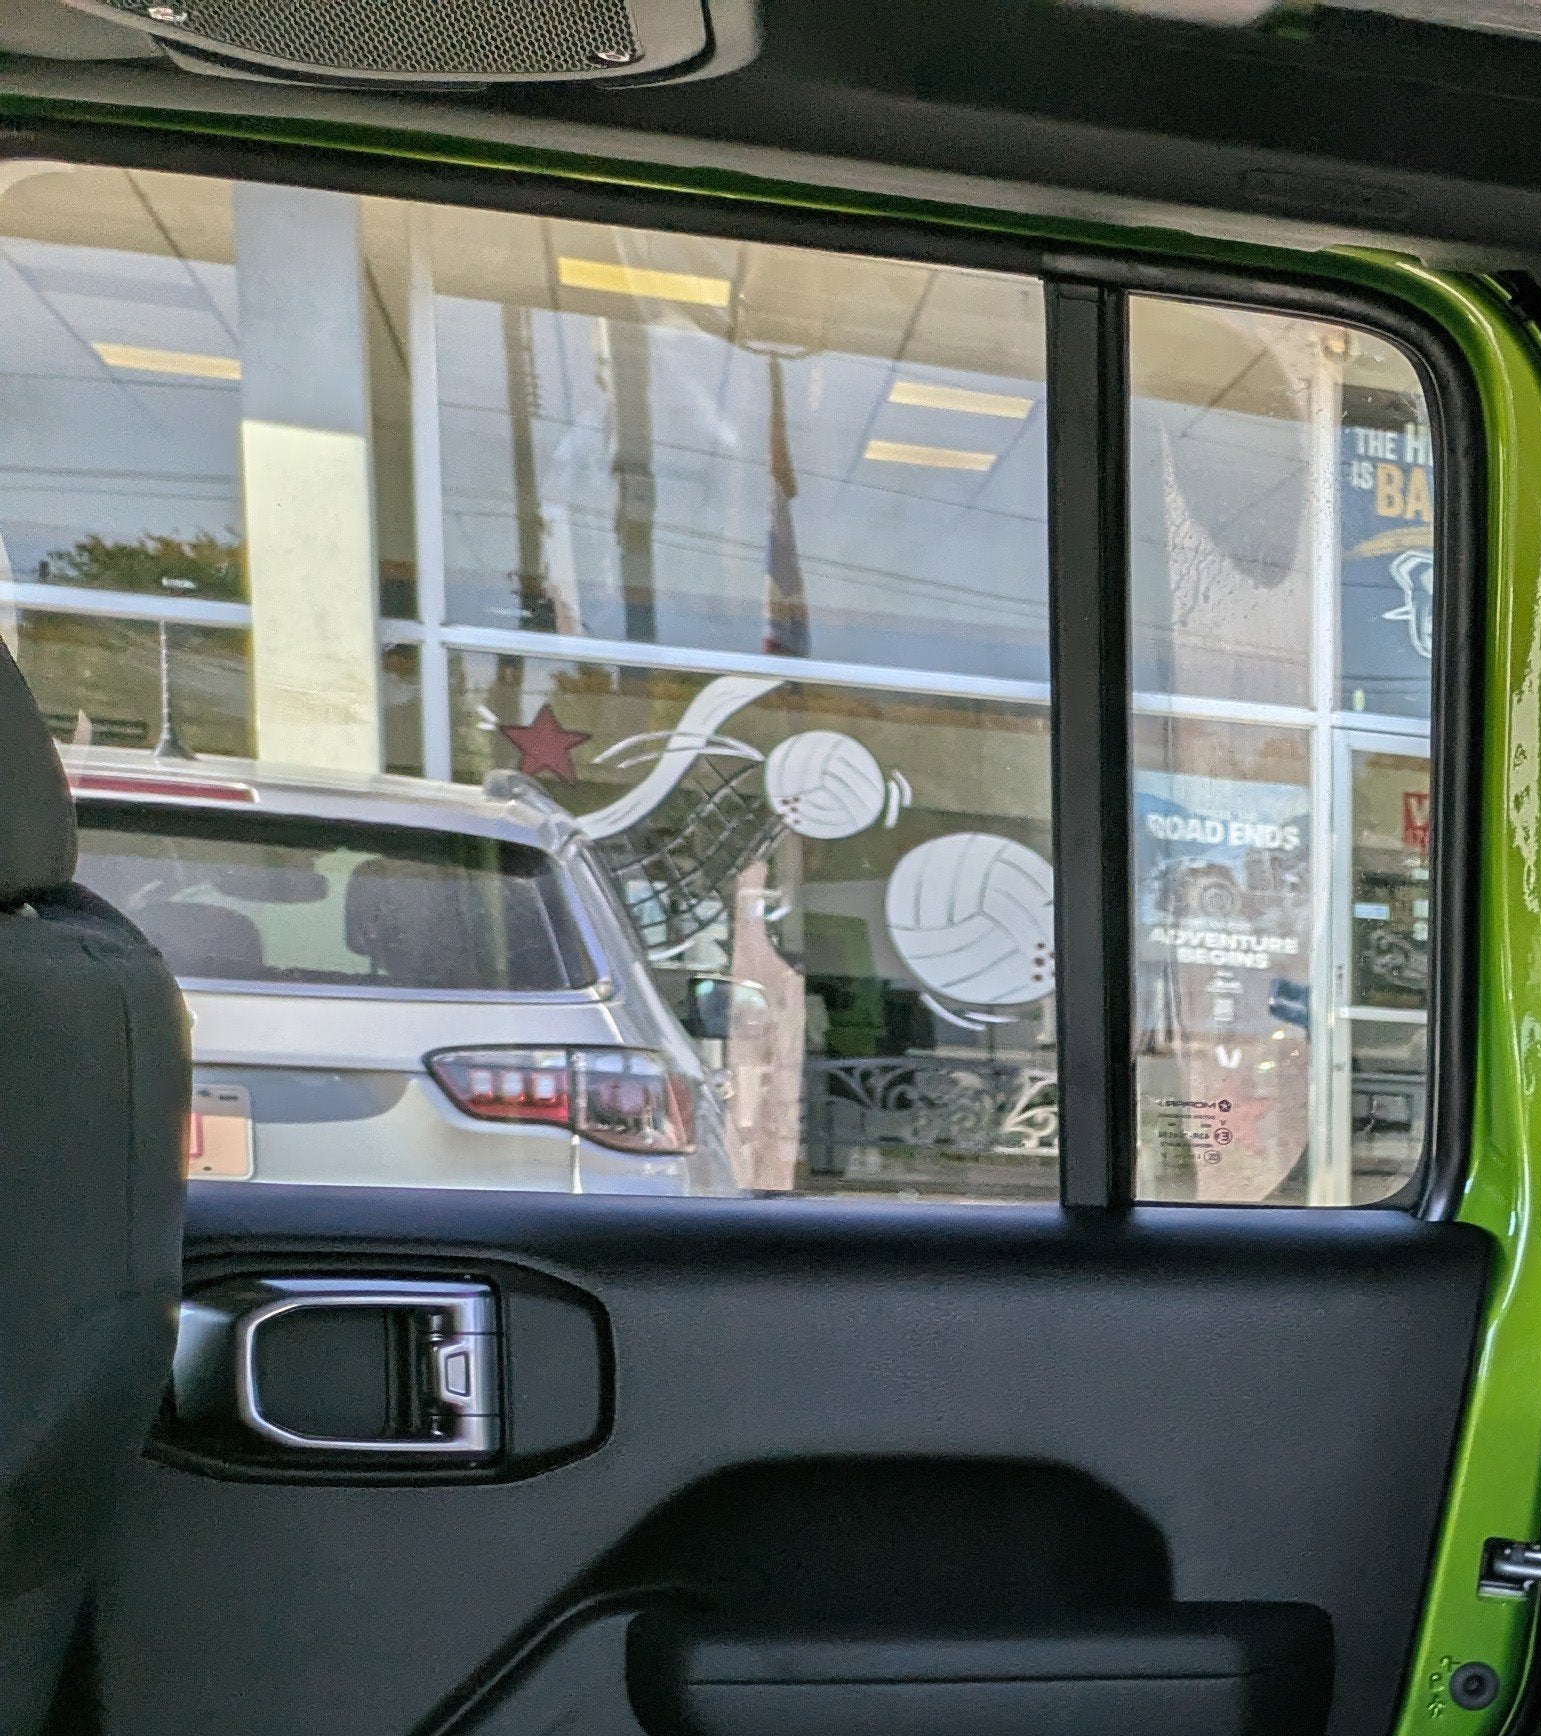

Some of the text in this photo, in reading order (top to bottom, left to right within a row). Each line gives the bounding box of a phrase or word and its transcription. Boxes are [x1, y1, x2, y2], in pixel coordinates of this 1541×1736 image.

[1354, 426, 1398, 460] THE
[1350, 461, 1374, 490] IS
[1146, 813, 1225, 845] ROAD
[1229, 821, 1301, 851] ENDS
[1149, 926, 1299, 955] ADVENTURE
[1176, 946, 1271, 969] BEGINS
